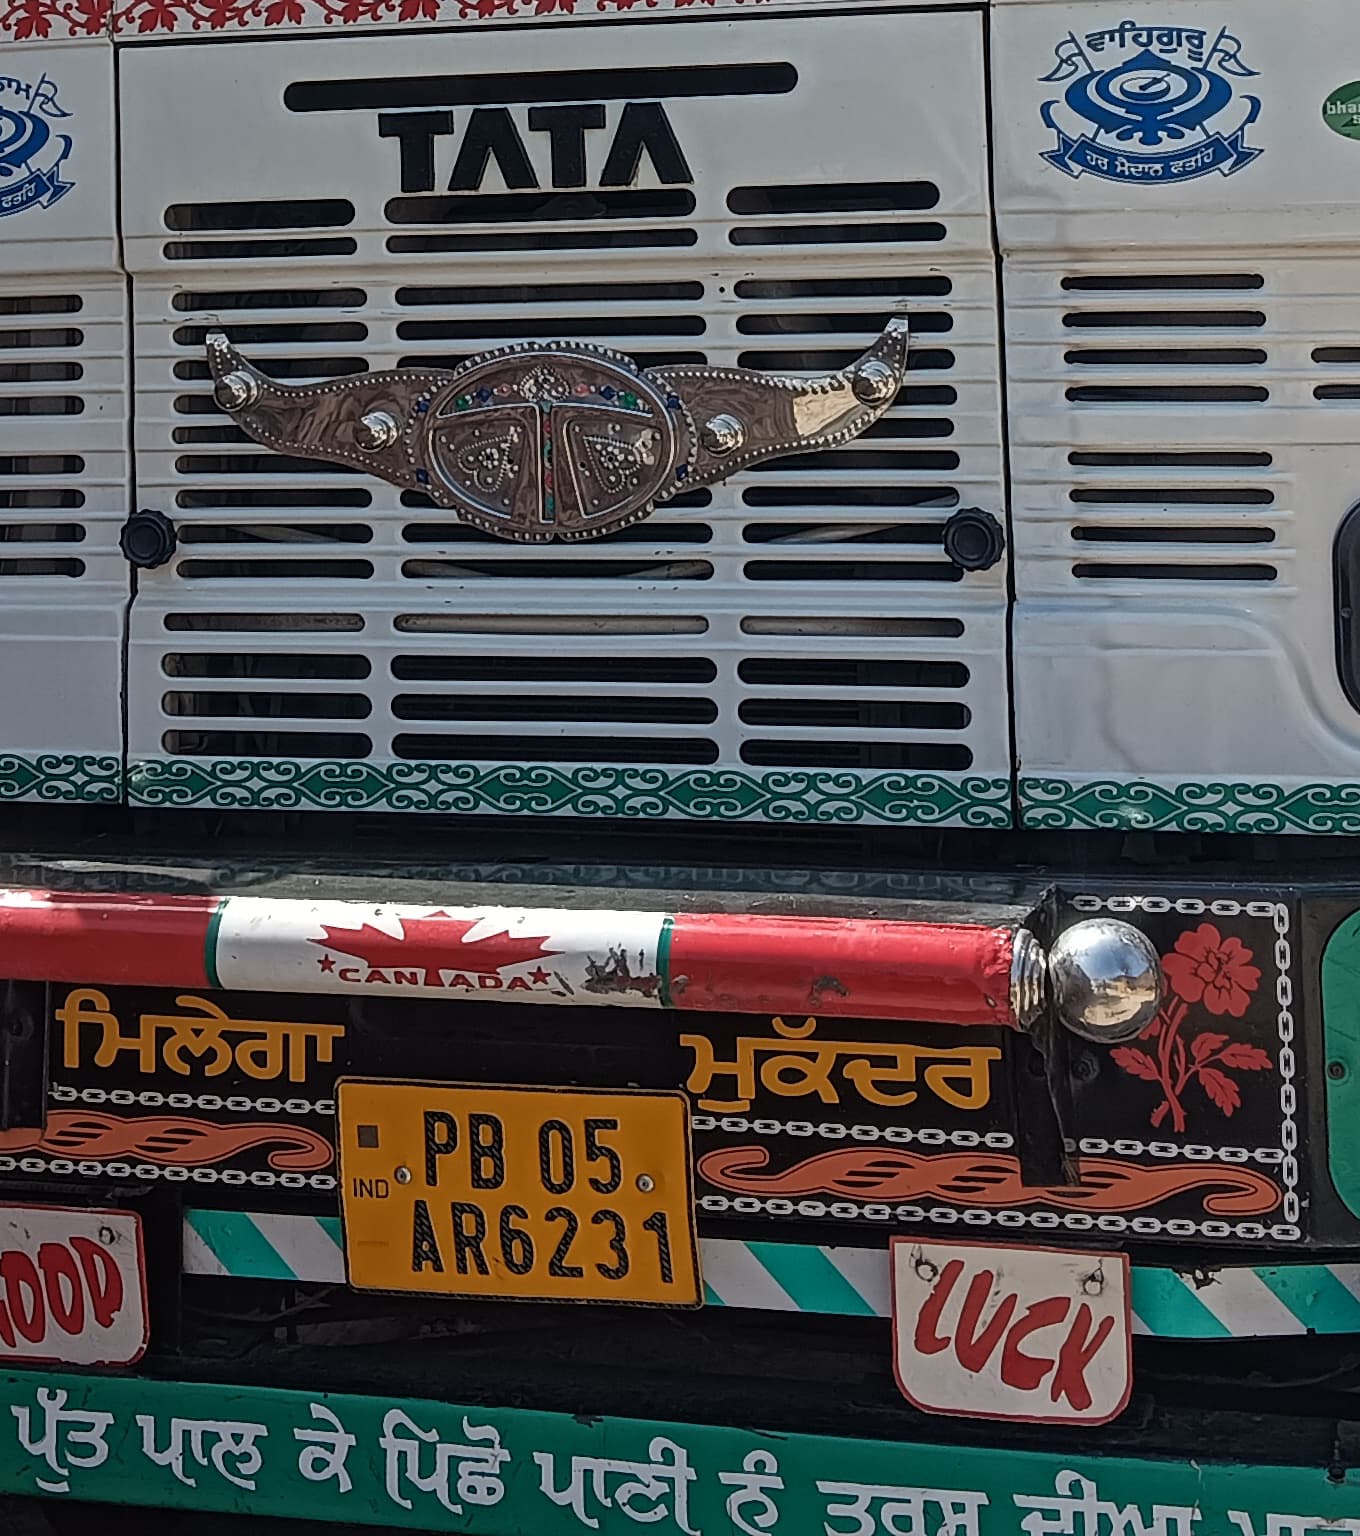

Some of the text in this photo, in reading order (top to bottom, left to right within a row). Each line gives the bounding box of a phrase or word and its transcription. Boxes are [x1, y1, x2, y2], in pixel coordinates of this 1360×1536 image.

[1085, 20, 1207, 63] ਵਾਹਿਗੁਰੂ
[377, 101, 695, 195] TATA
[337, 966, 538, 993] CANADA
[55, 988, 346, 1083] ਮਿਲੇਗਾ
[352, 1178, 390, 1200] IND
[423, 1110, 622, 1195] PB 05
[411, 1199, 674, 1284] AR6231
[913, 1259, 1115, 1411] LUCK
[11, 1387, 114, 1493] ਪੁੱਤ
[134, 1413, 269, 1492] ਪਾਲ
[293, 1402, 357, 1494] ਕੇ
[533, 1435, 702, 1536] ਪਾਣੀ
